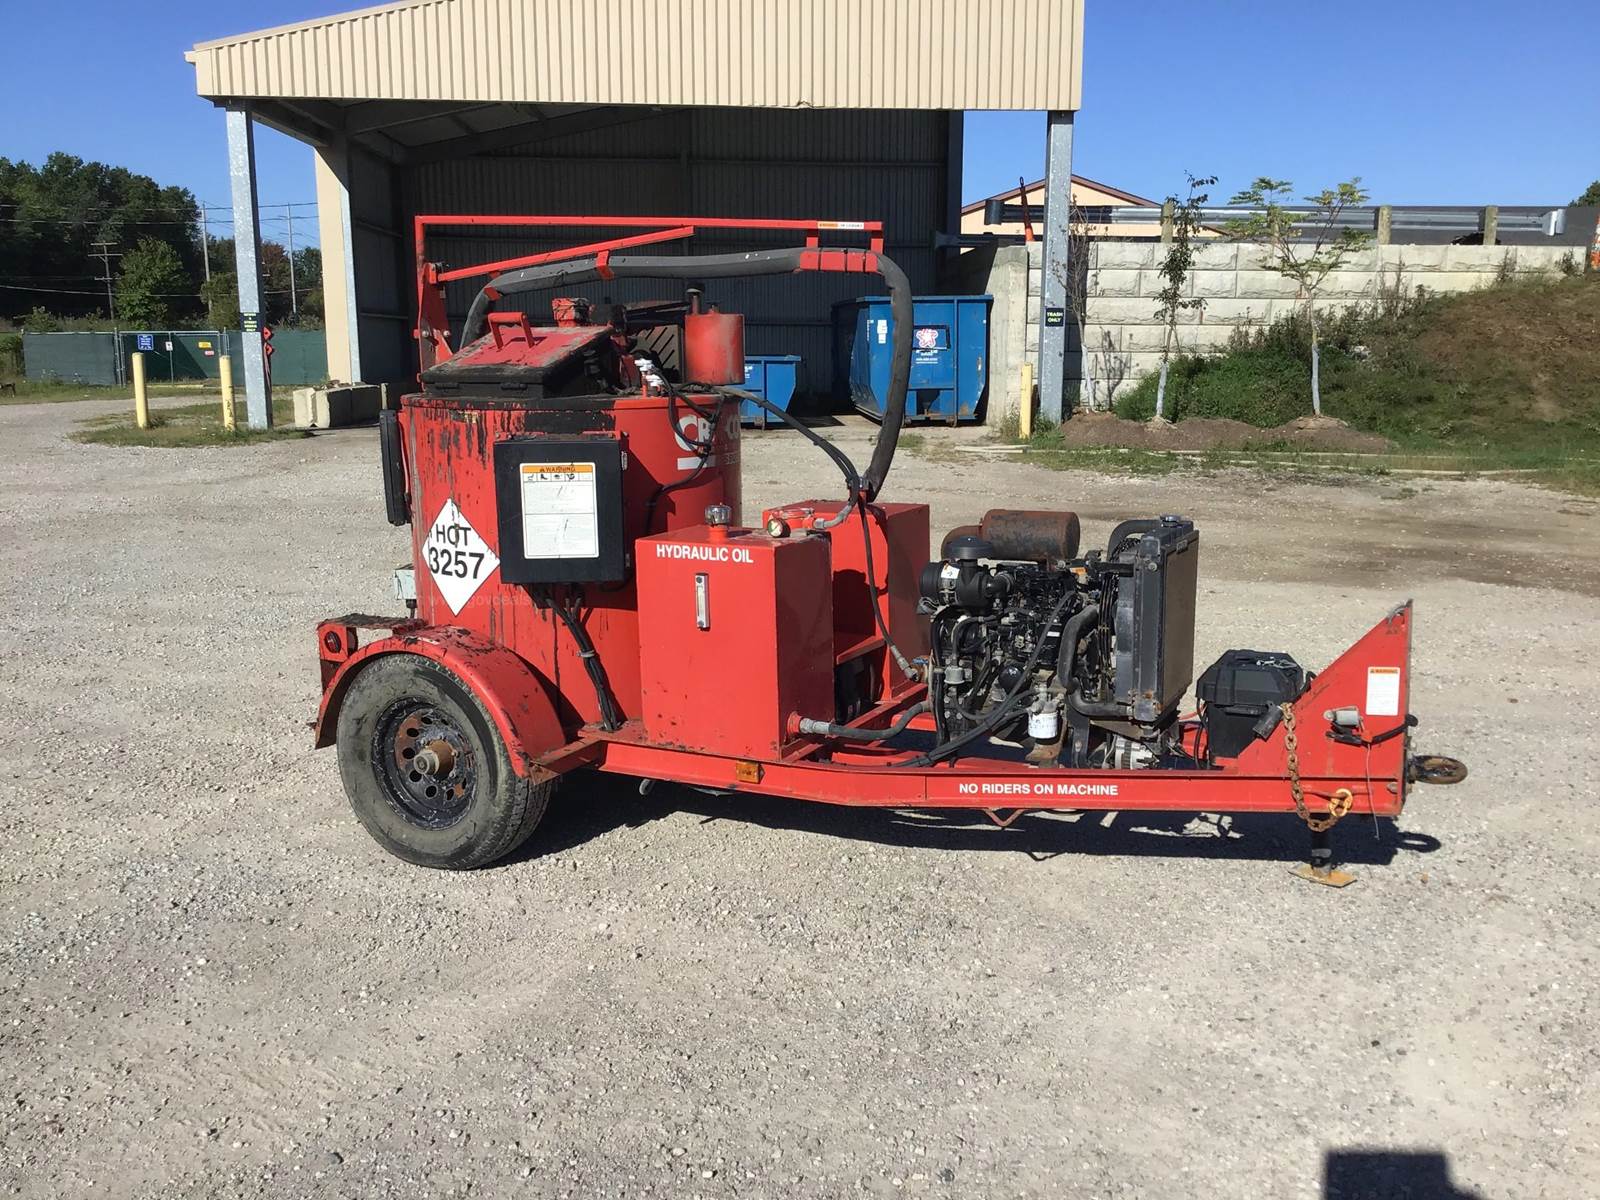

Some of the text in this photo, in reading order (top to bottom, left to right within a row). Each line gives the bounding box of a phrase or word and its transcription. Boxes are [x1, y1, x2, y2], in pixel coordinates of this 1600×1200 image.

[436, 523, 471, 547] HOT
[429, 546, 484, 579] 3257
[656, 543, 753, 563] HYDRAULIC OIL
[959, 783, 1118, 795] NO RIDERS ON MACHINE
